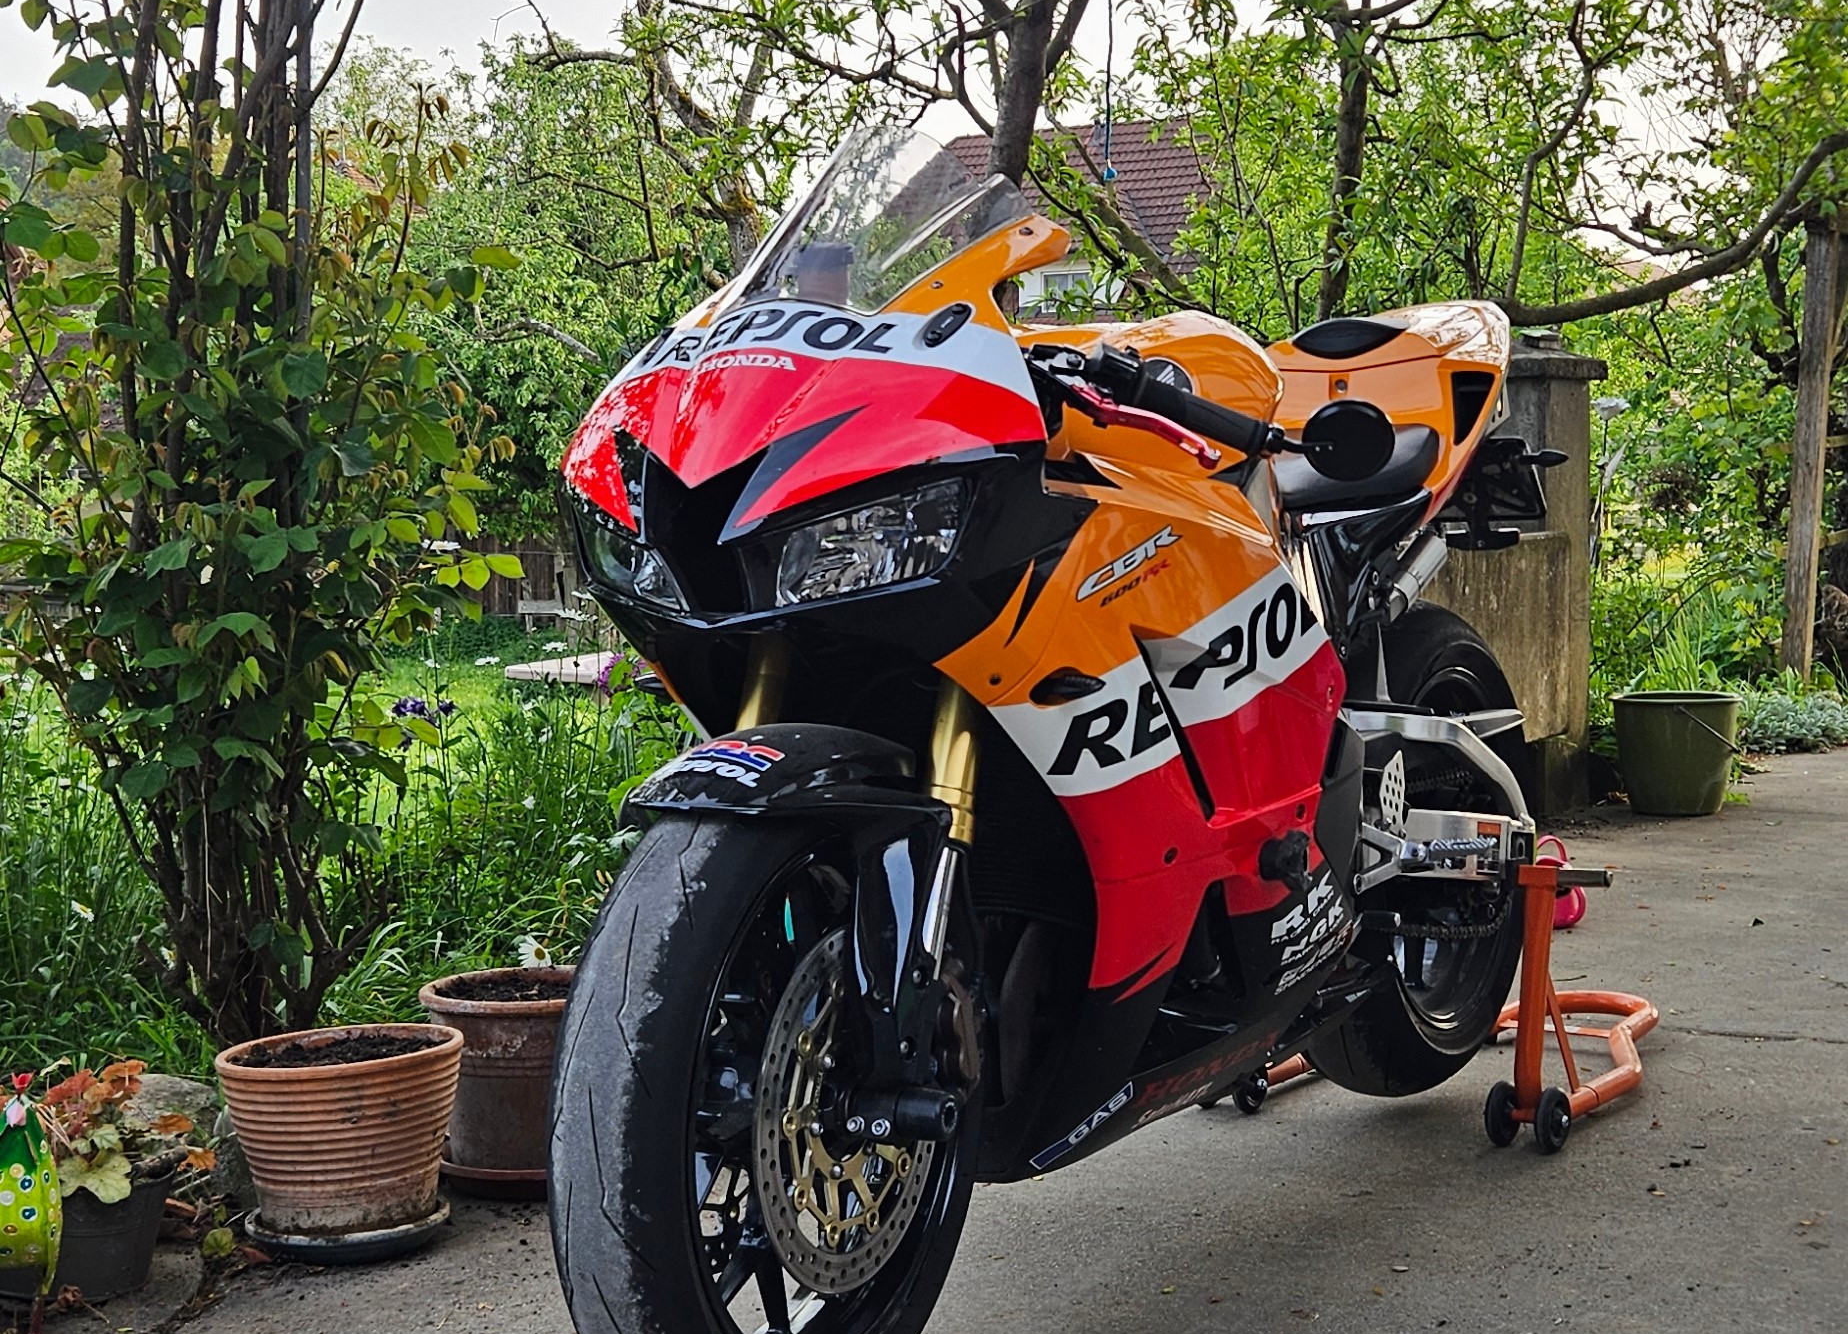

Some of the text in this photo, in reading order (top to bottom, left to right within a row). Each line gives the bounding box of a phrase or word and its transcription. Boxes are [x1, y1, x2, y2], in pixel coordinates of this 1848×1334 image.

[652, 309, 897, 367] REPSOL
[699, 353, 797, 373] HONDA
[1076, 524, 1182, 602] CBR
[1271, 869, 1333, 939] RK
[1281, 894, 1344, 961] NGK
[1068, 1092, 1128, 1145] GAS
